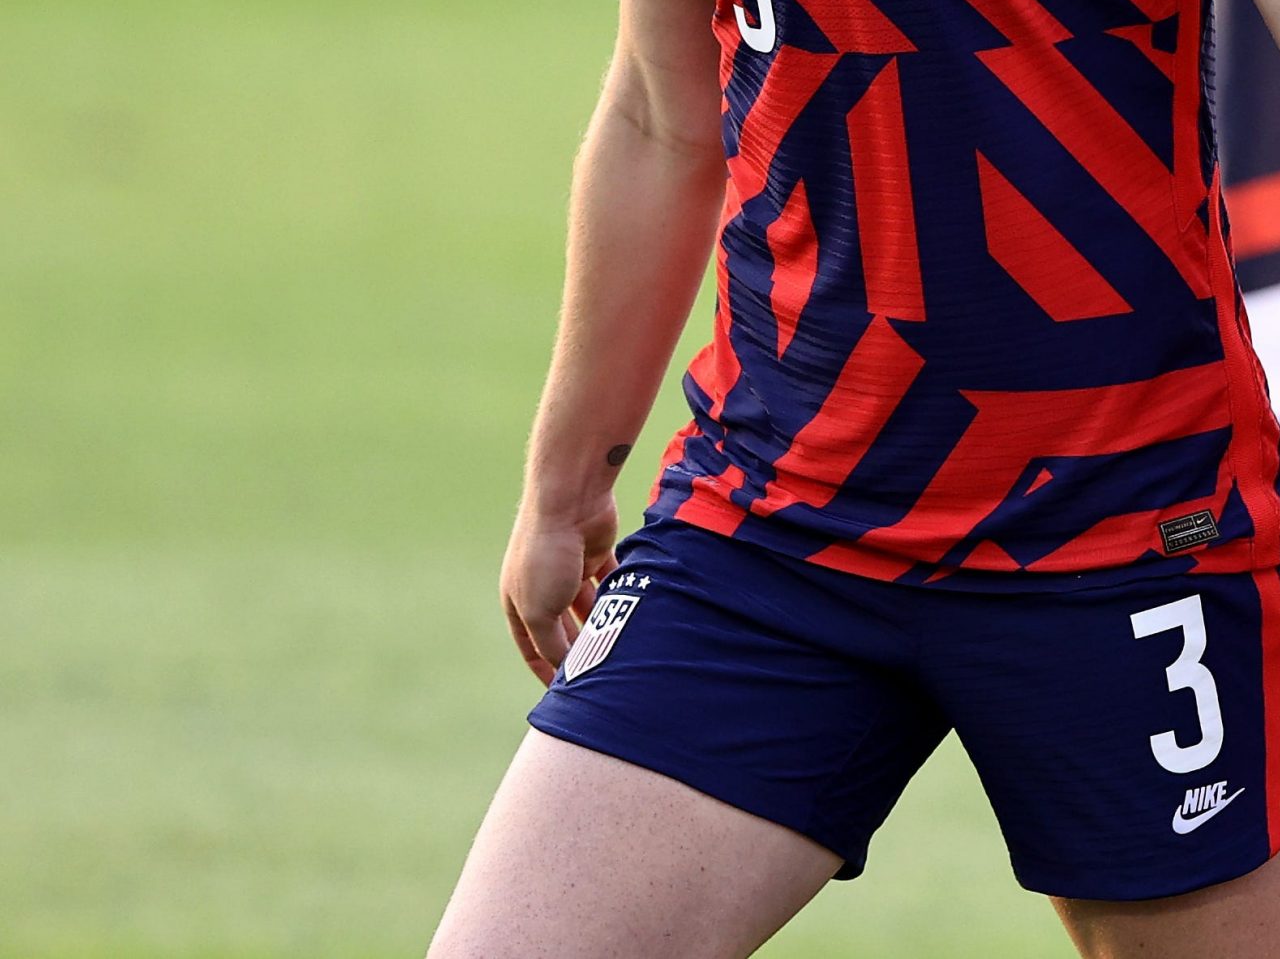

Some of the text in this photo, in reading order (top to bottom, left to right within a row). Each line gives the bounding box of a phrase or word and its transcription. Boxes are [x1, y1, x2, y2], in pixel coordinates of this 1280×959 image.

[590, 598, 634, 631] USA
[1129, 594, 1225, 774] 3
[1180, 781, 1228, 815] NIKE
